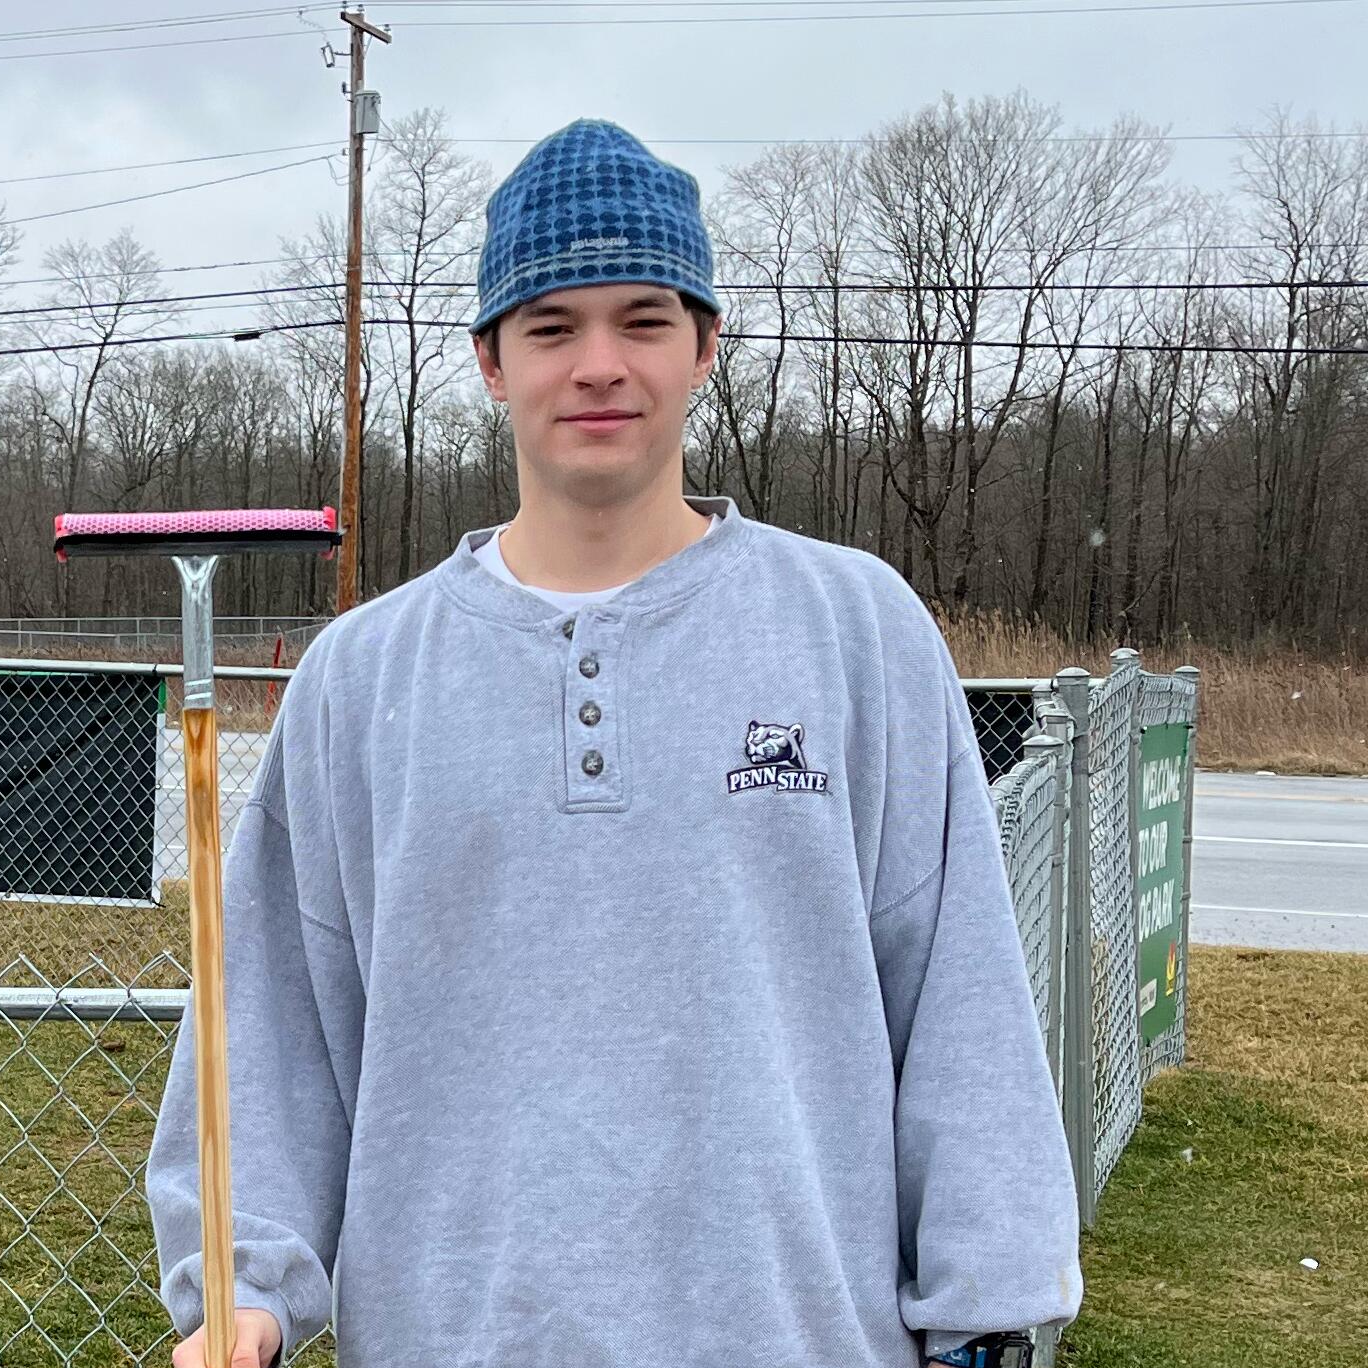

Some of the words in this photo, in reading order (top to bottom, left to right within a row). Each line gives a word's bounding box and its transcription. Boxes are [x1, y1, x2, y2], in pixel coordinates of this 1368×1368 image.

[729, 766, 777, 791] PENN
[777, 771, 826, 791] STATE
[1142, 755, 1181, 811] WELCOME
[1149, 820, 1168, 874] OUR
[1151, 878, 1175, 935] PARK
